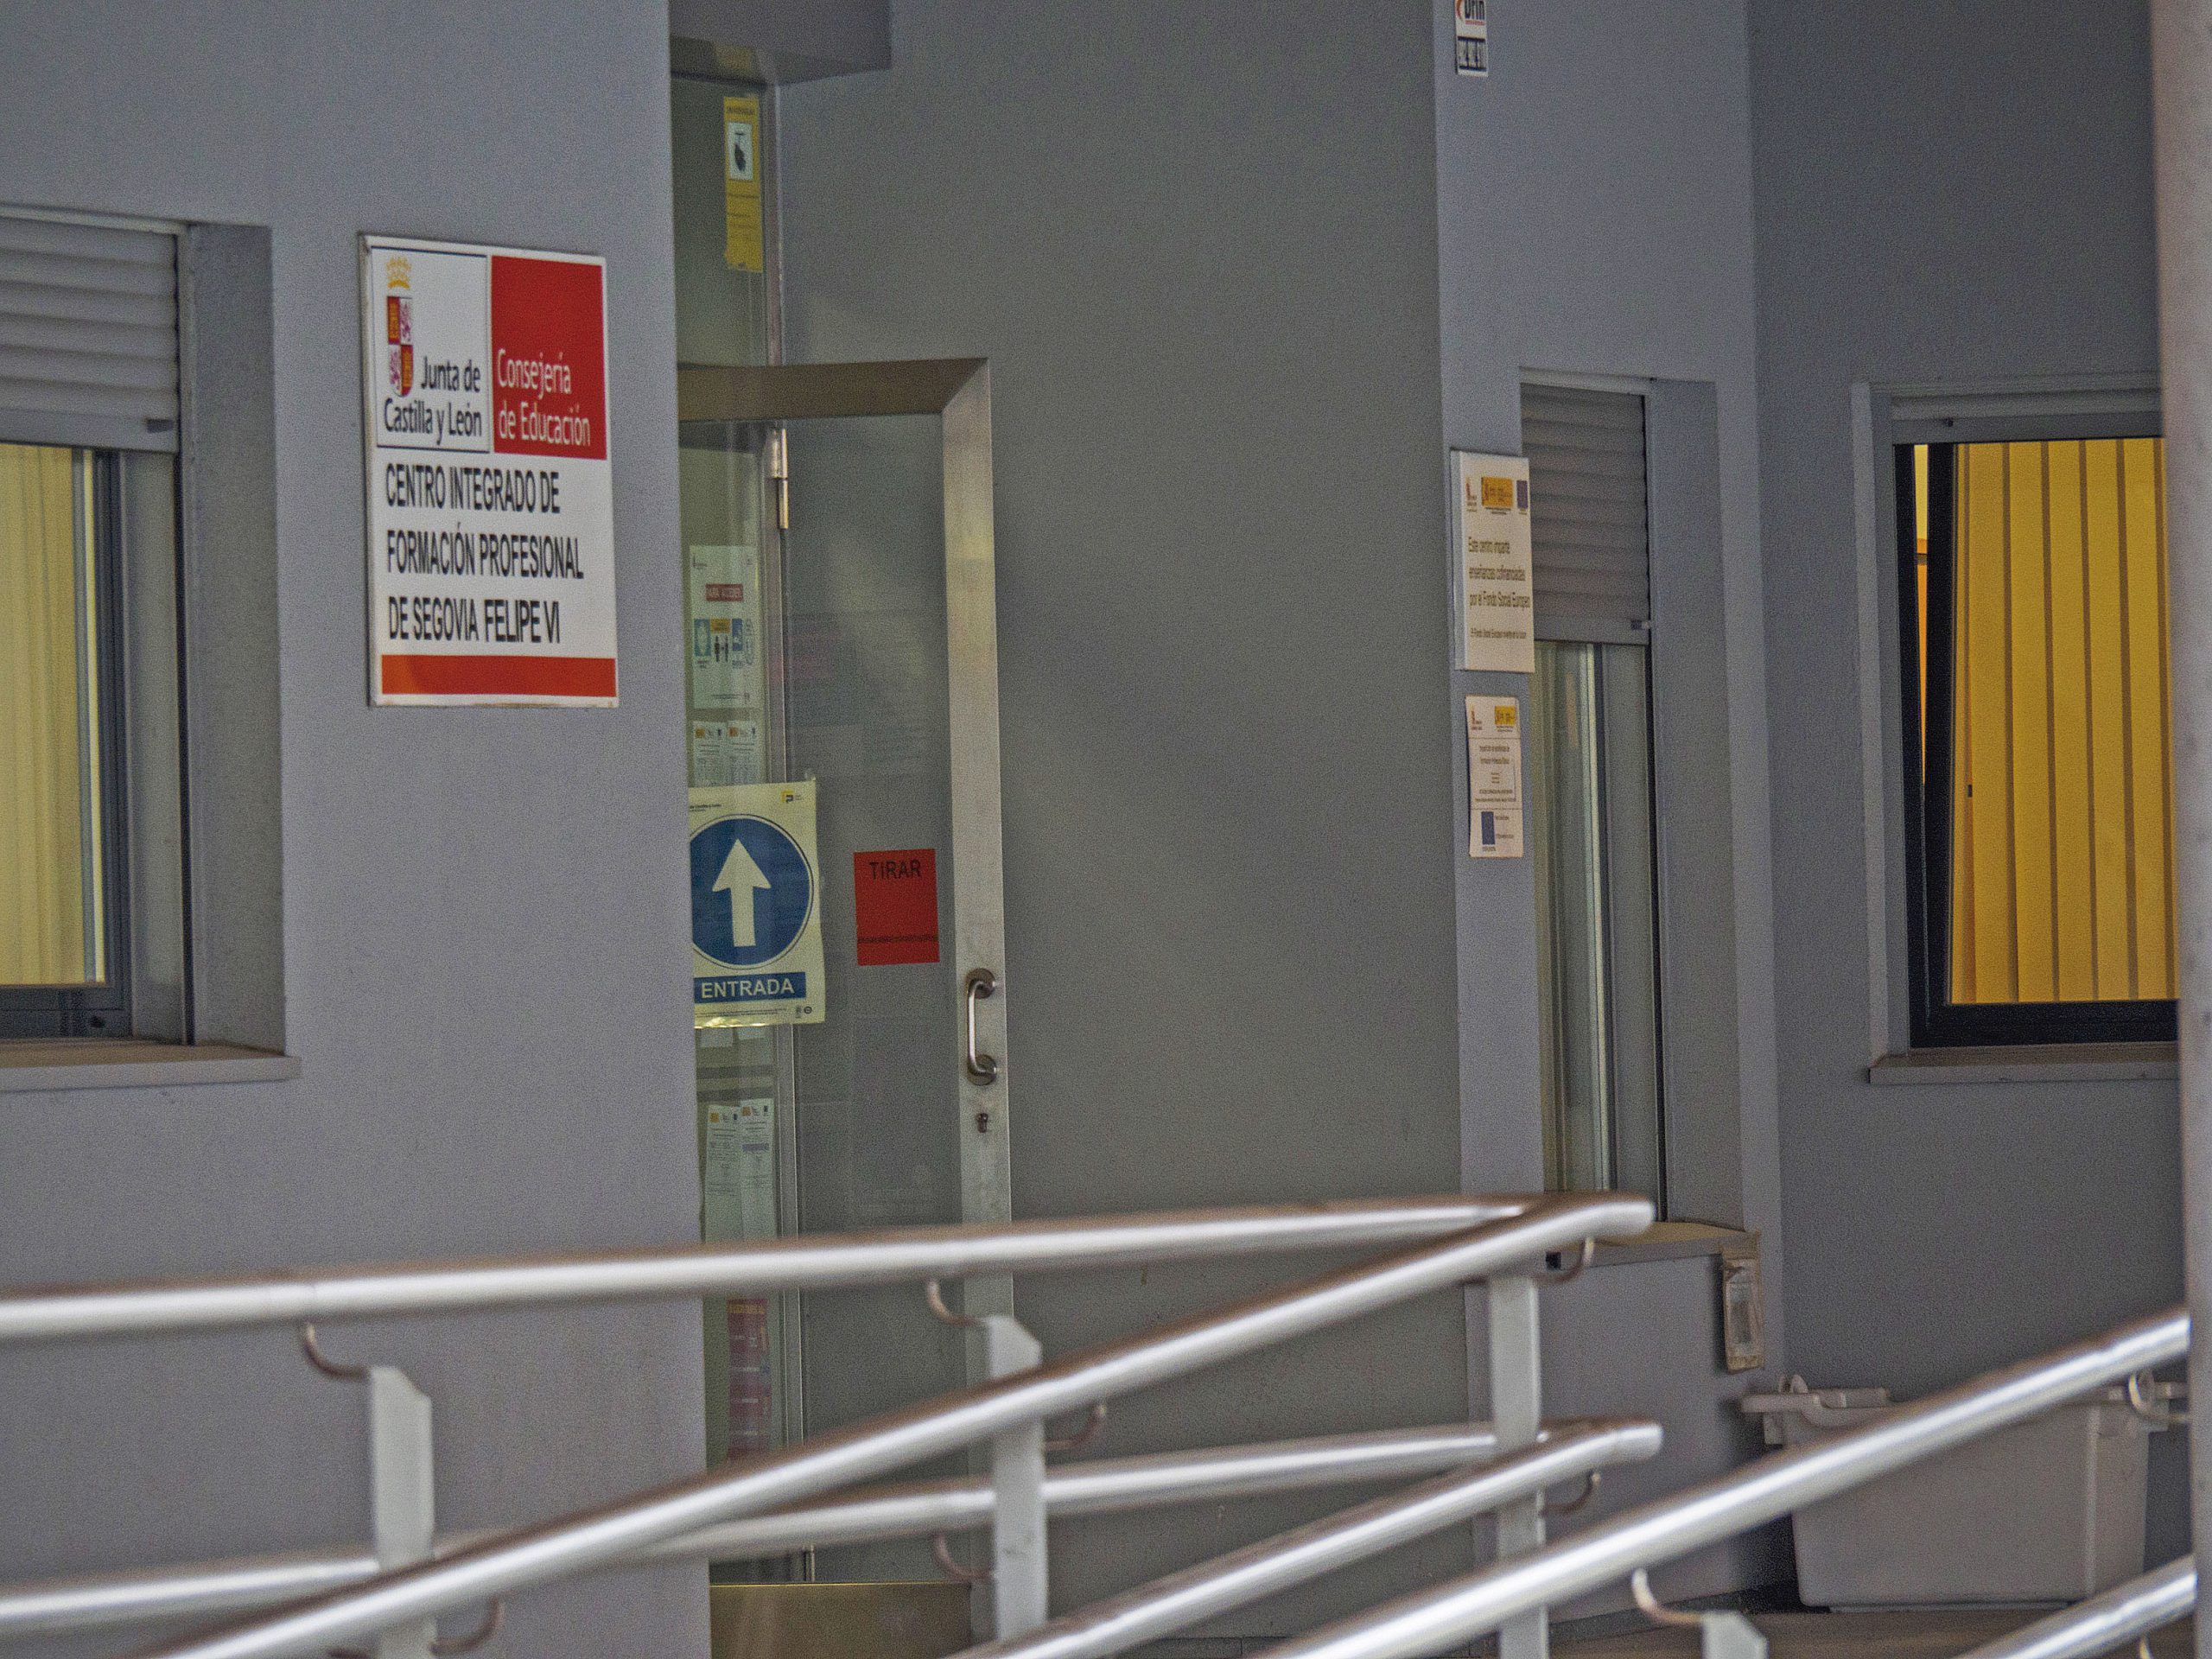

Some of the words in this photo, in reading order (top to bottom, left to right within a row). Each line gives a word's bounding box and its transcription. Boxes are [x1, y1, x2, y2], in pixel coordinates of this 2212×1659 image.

[421, 356, 460, 392] Junta
[463, 359, 481, 393] de
[496, 347, 572, 400] Consejería
[384, 398, 434, 435] Castilla
[436, 410, 445, 445] y
[448, 402, 482, 436] León
[499, 400, 517, 440] de
[520, 401, 591, 447] Educación
[385, 463, 446, 510] CENTRO
[449, 467, 537, 513] INTEGRADO
[539, 470, 561, 514] DE
[387, 522, 475, 576] FORMACIÓN
[479, 533, 584, 579] PROFESIONAL
[388, 596, 409, 640] DE
[413, 596, 479, 642] SEGOVIA
[483, 599, 542, 643] FELIPE
[543, 601, 561, 644] VI
[868, 859, 923, 881] TIRAR
[700, 977, 796, 1000] ENTRADA
